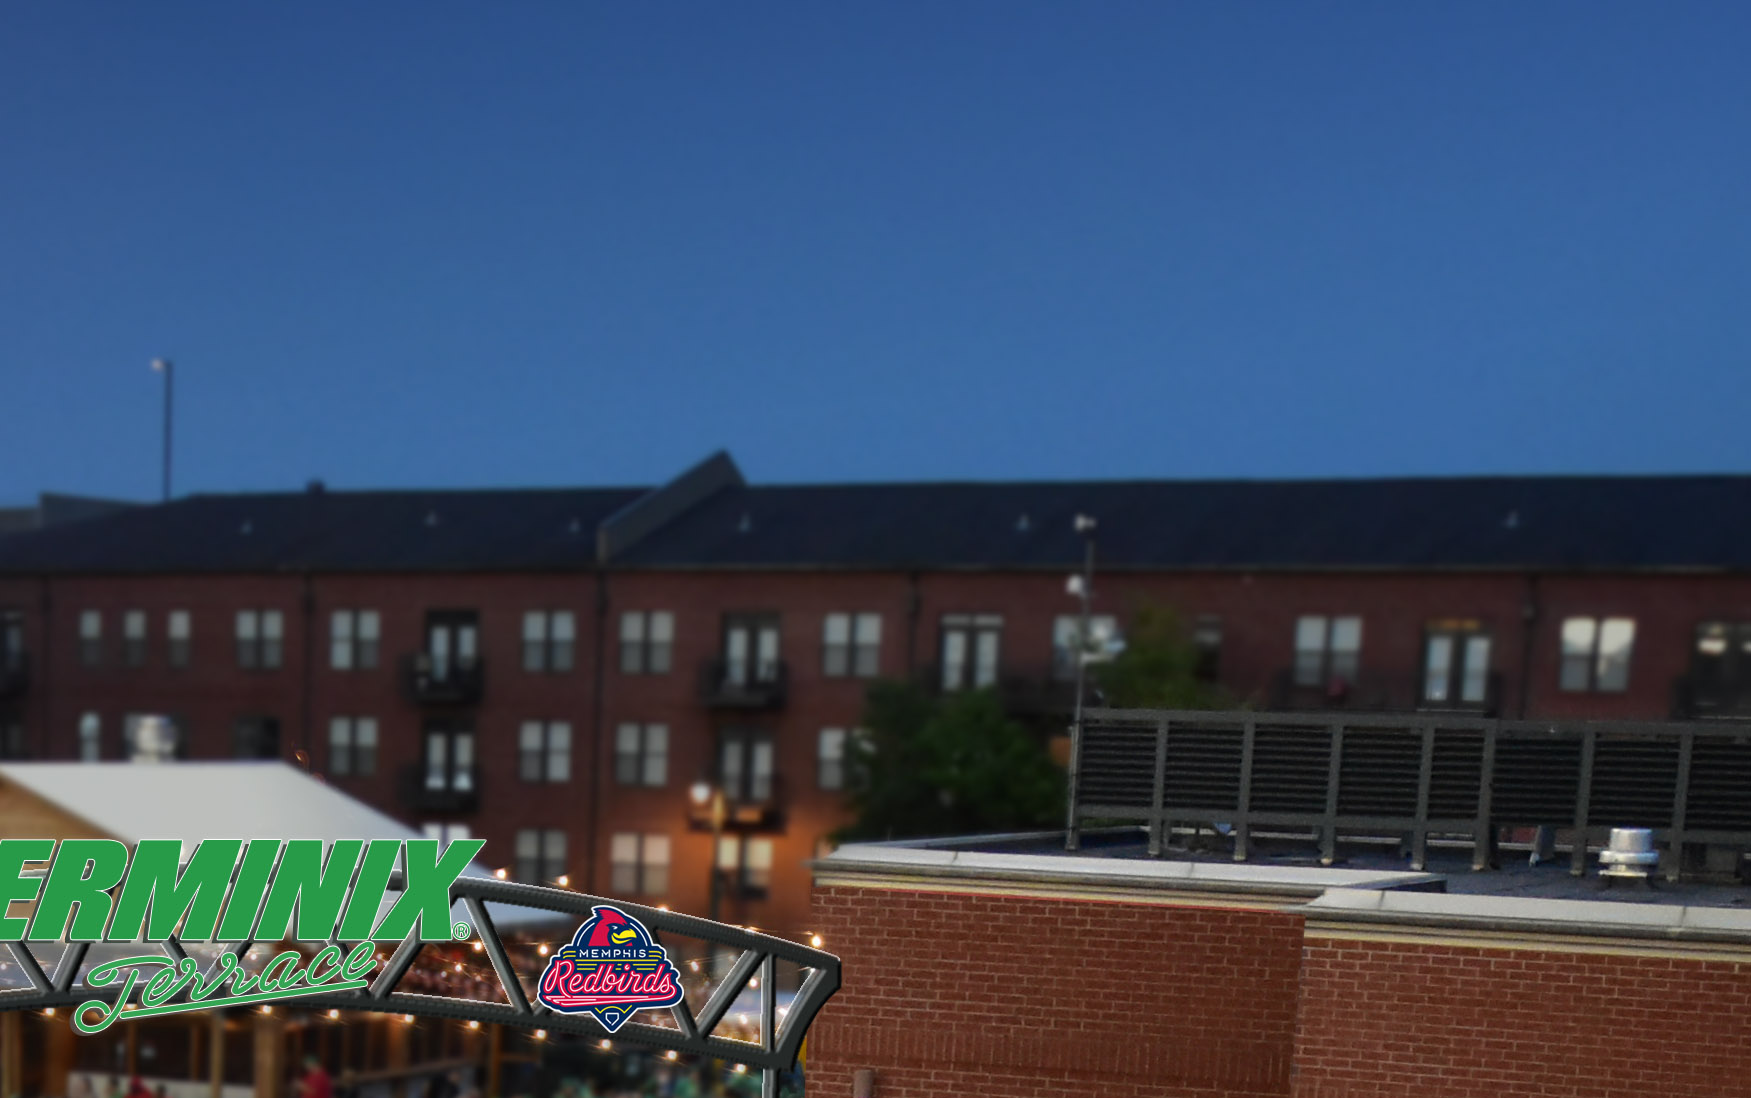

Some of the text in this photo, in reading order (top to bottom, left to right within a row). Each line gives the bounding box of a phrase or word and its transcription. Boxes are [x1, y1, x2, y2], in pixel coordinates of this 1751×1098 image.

[579, 949, 647, 958] MEMPHIS
[74, 940, 377, 1034] Terrace
[542, 959, 676, 1003] Redbirds
